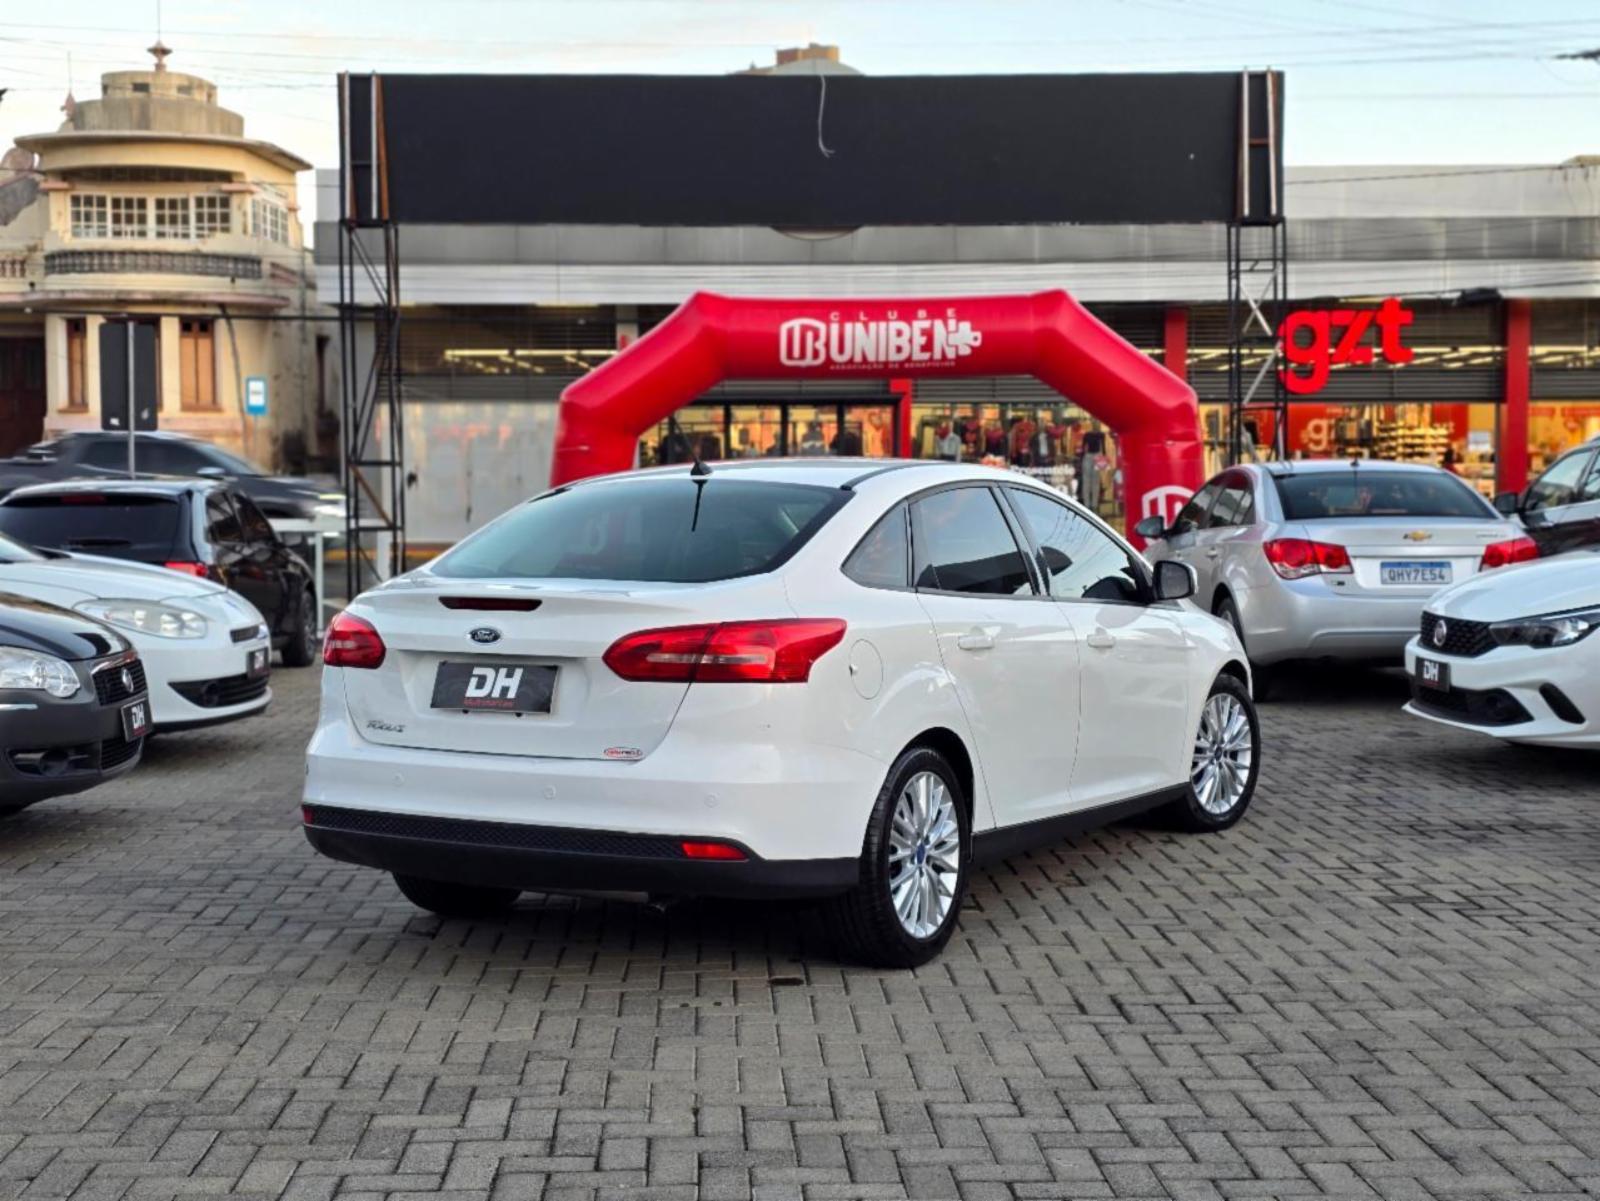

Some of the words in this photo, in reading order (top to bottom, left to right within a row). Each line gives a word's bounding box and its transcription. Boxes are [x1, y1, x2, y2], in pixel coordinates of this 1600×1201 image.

[829, 308, 957, 322] CLUBE
[1278, 297, 1414, 394] gzt
[464, 666, 524, 699] DH
[1423, 660, 1440, 682] DH
